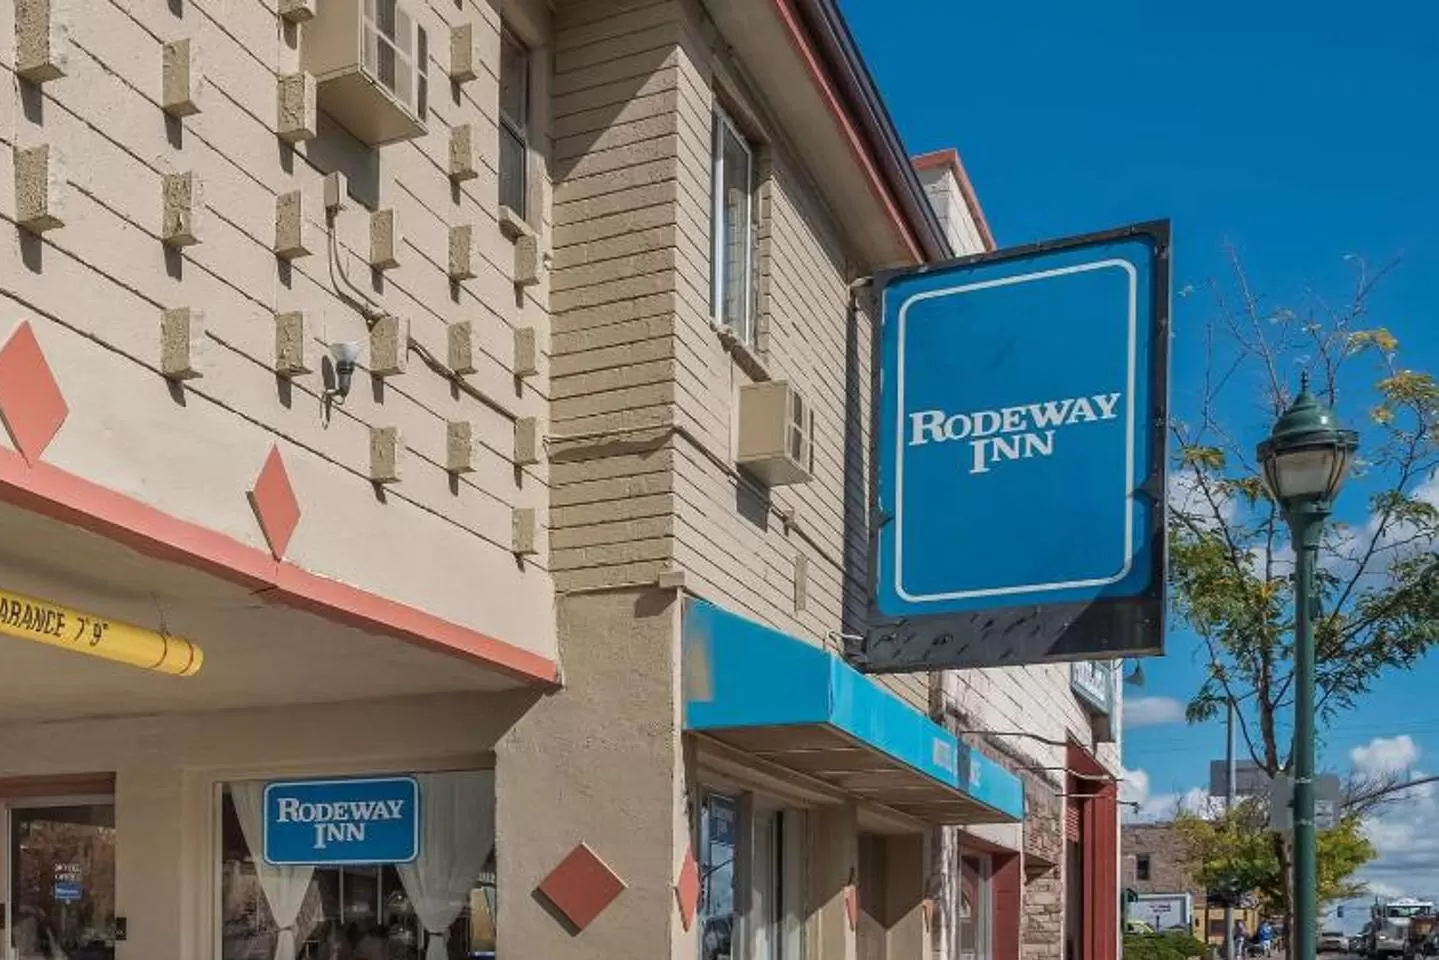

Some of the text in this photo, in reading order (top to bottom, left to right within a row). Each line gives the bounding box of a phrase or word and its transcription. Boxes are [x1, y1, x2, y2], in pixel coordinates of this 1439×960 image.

[908, 393, 1121, 446] RODEWAY
[969, 430, 1055, 474] INN
[276, 798, 404, 822] RODEWAY
[312, 823, 366, 849] INN
